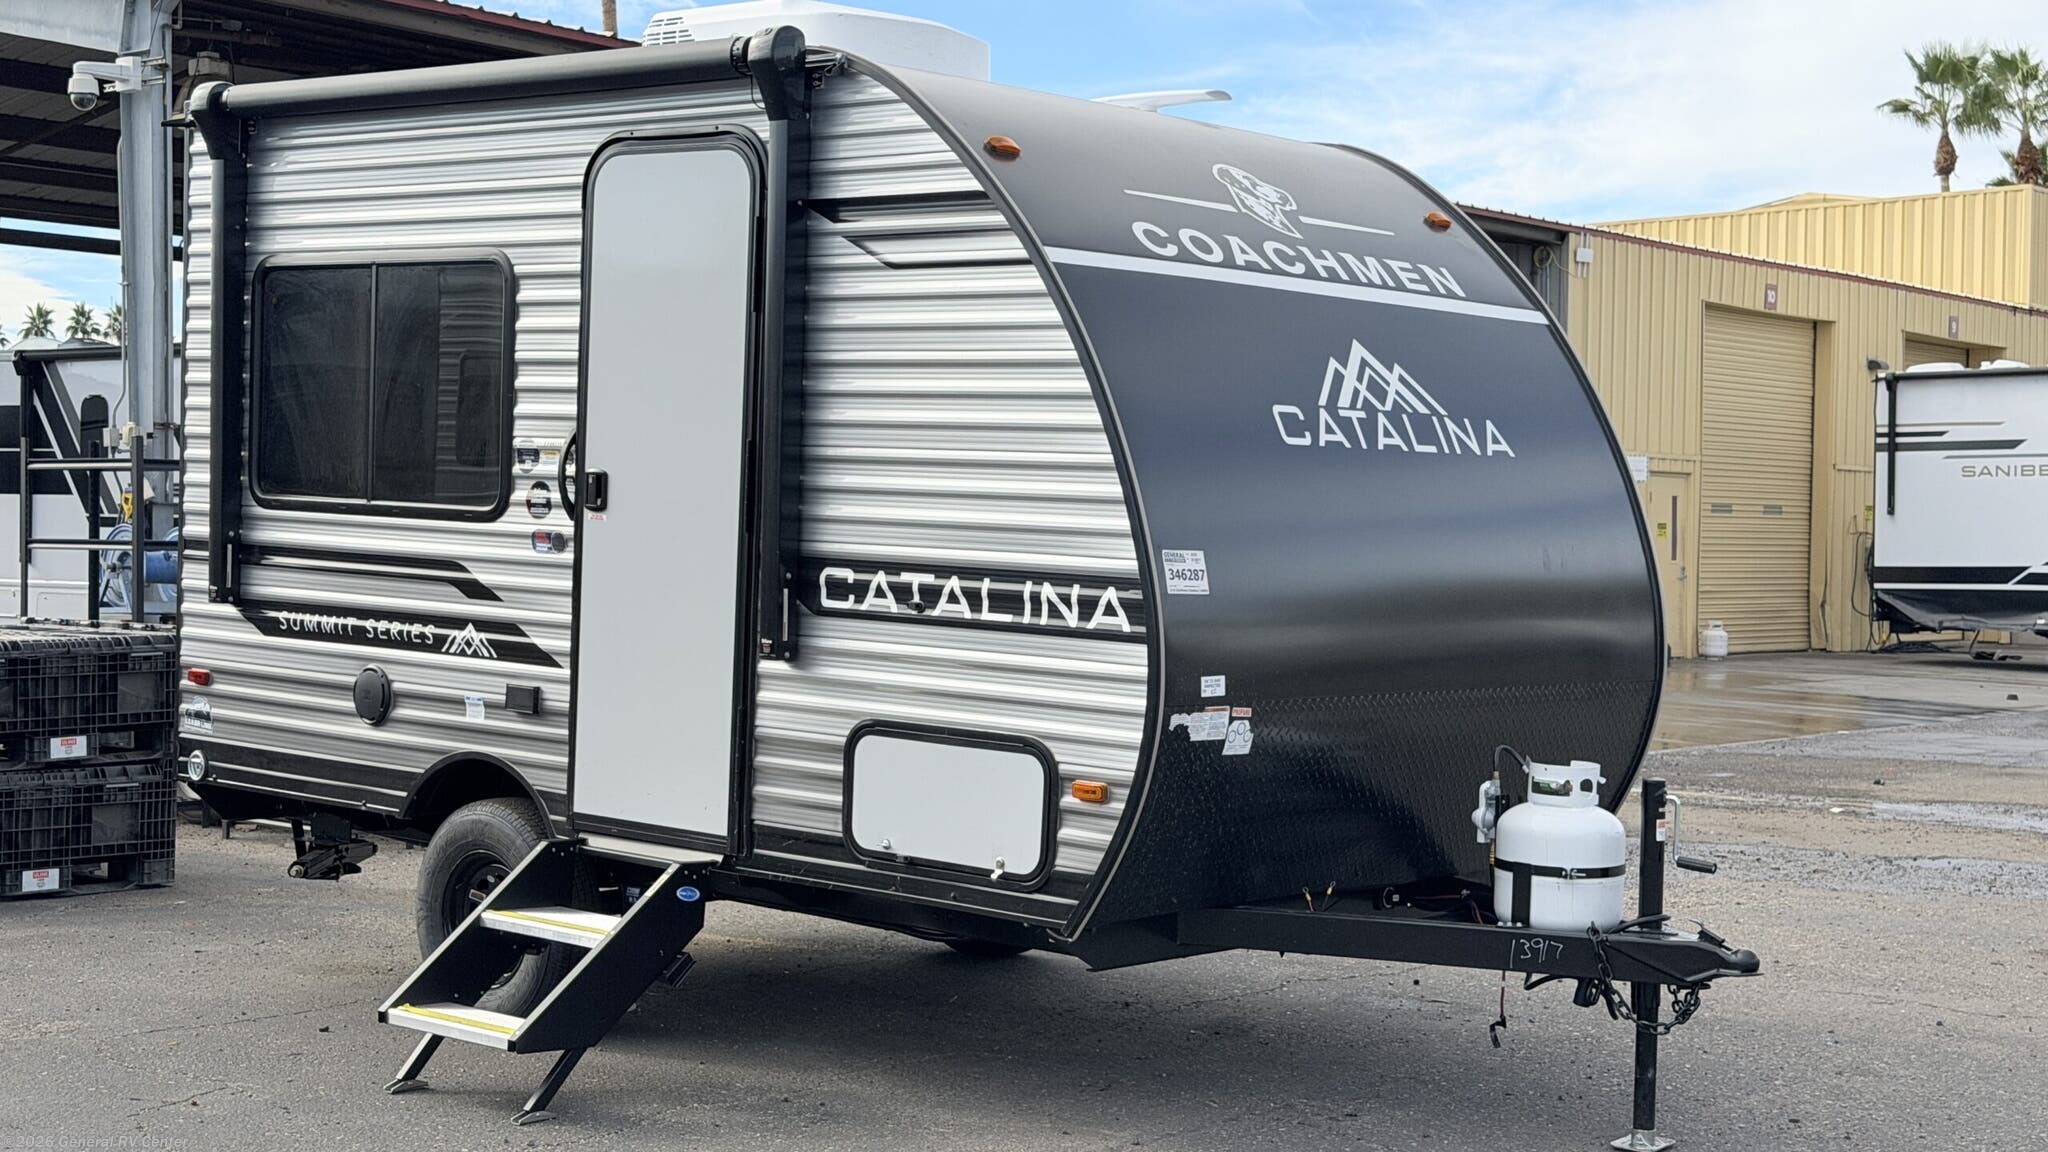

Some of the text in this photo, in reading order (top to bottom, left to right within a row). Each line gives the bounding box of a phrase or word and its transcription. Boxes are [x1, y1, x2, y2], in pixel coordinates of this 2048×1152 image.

[1131, 221, 1467, 298] COACHMEN
[1766, 289, 1776, 304] 10
[1272, 404, 1516, 458] CATALINA
[1168, 568, 1205, 581] 346287
[819, 566, 1131, 633] CATALINA
[279, 610, 436, 645] SUMMIT SERIES
[1510, 938, 1563, 968] 13917
